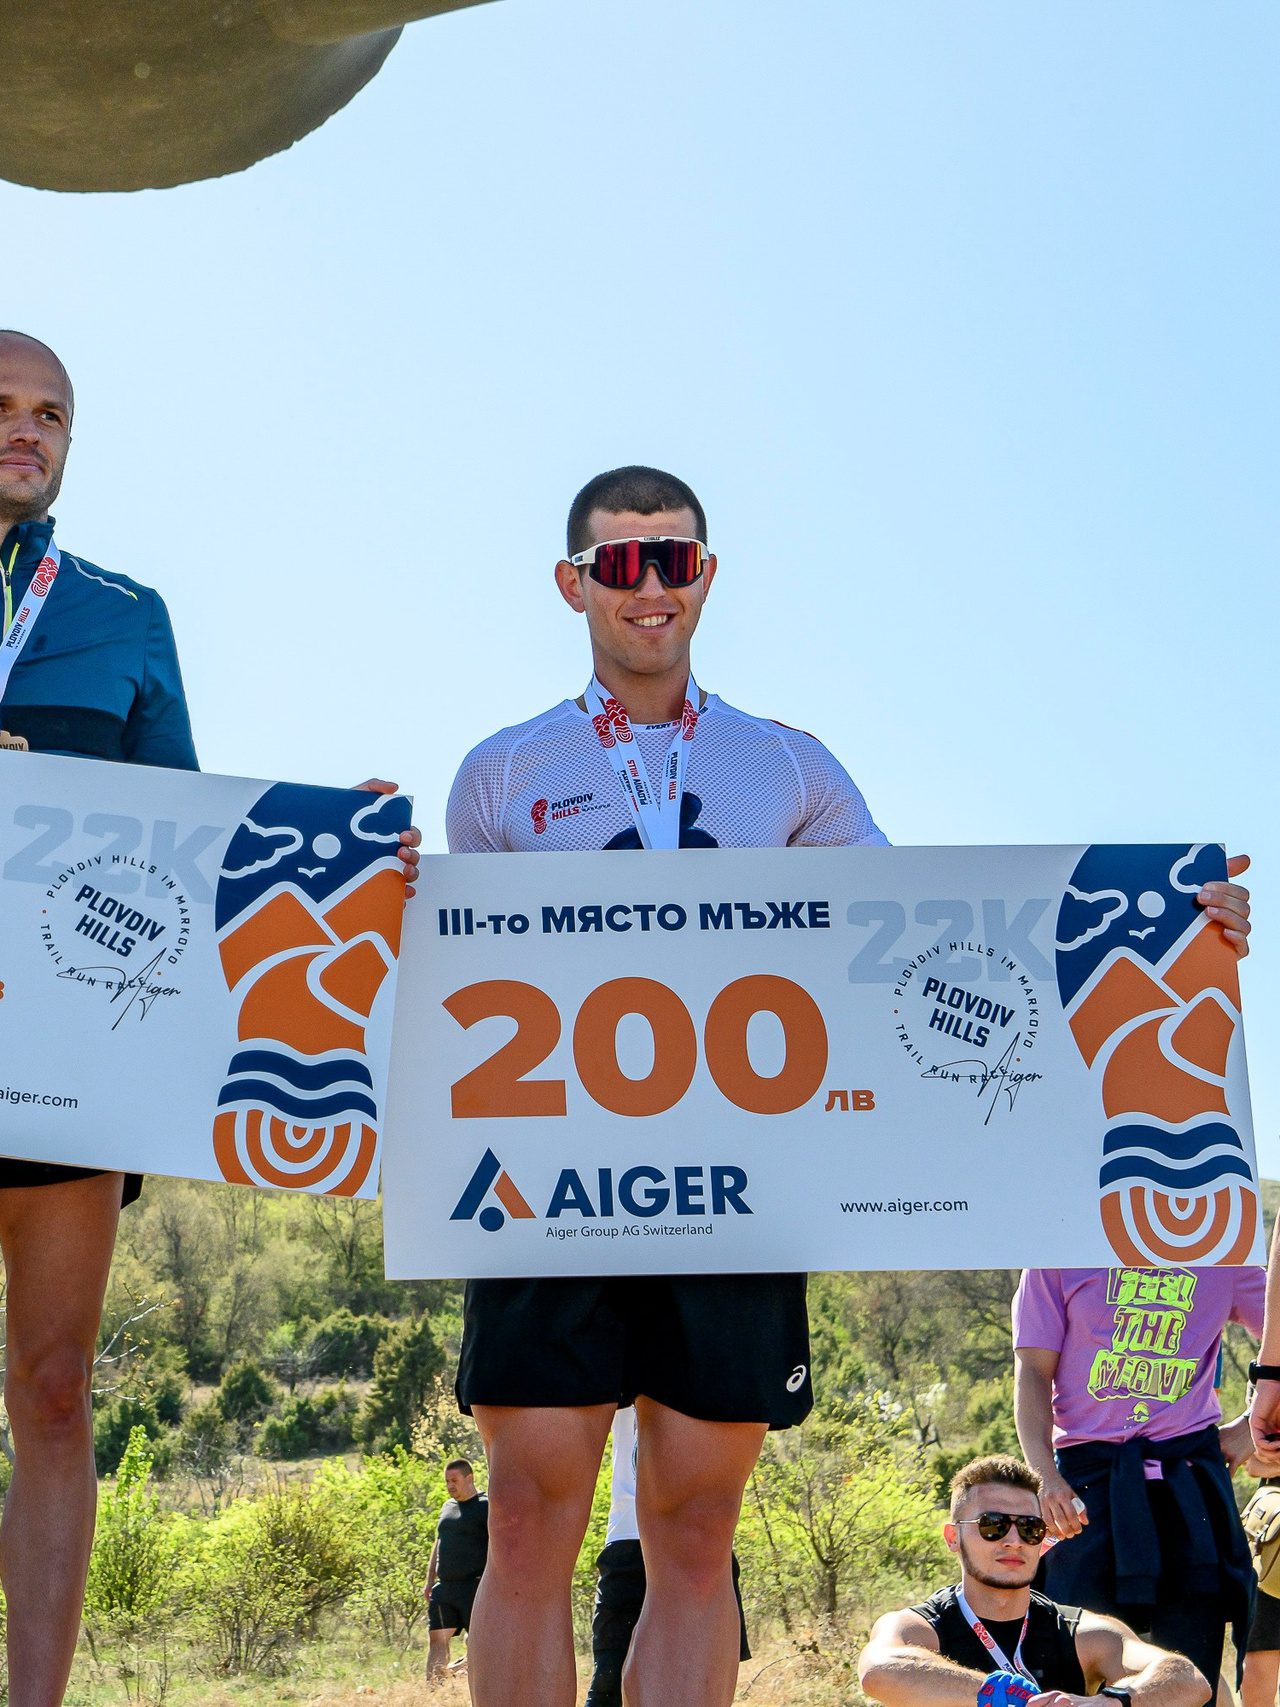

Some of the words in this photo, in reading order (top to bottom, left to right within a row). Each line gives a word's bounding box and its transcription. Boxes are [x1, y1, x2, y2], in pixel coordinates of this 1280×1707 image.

[551, 792, 593, 811] PLOVDIV
[551, 806, 579, 820] HILLS
[2, 804, 226, 905] 22K
[46, 855, 102, 898] PLOVDIV
[112, 855, 157, 874] HILLS
[161, 875, 176, 890] IN
[74, 884, 166, 942] PLOVDIV
[74, 914, 137, 958] HILLS
[168, 895, 190, 965] MARKOVO
[541, 903, 688, 934] МЯСТО
[698, 901, 831, 931] МЪЖЕ
[40, 924, 63, 965] TRAIL
[66, 966, 96, 986] RUN
[846, 898, 1056, 984] 22K
[894, 945, 941, 997] PLOVDIV
[949, 941, 994, 957] HILLS
[1000, 956, 1016, 971] IN
[1017, 975, 1039, 1049] MARKOVO
[922, 976, 1016, 1028] PLOVDIV
[441, 973, 829, 1119] 200
[895, 1024, 923, 1065] TRAIL
[930, 1064, 960, 1083] RUN
[928, 1008, 991, 1048] HILLS
[545, 1165, 755, 1218] AIGER
[840, 1198, 969, 1215] www.aiger.com
[546, 1226, 578, 1240] Aiger
[580, 1225, 619, 1239] Group
[622, 1225, 640, 1236] AG
[642, 1223, 713, 1236] Switzerland
[1112, 1305, 1187, 1356] THE
